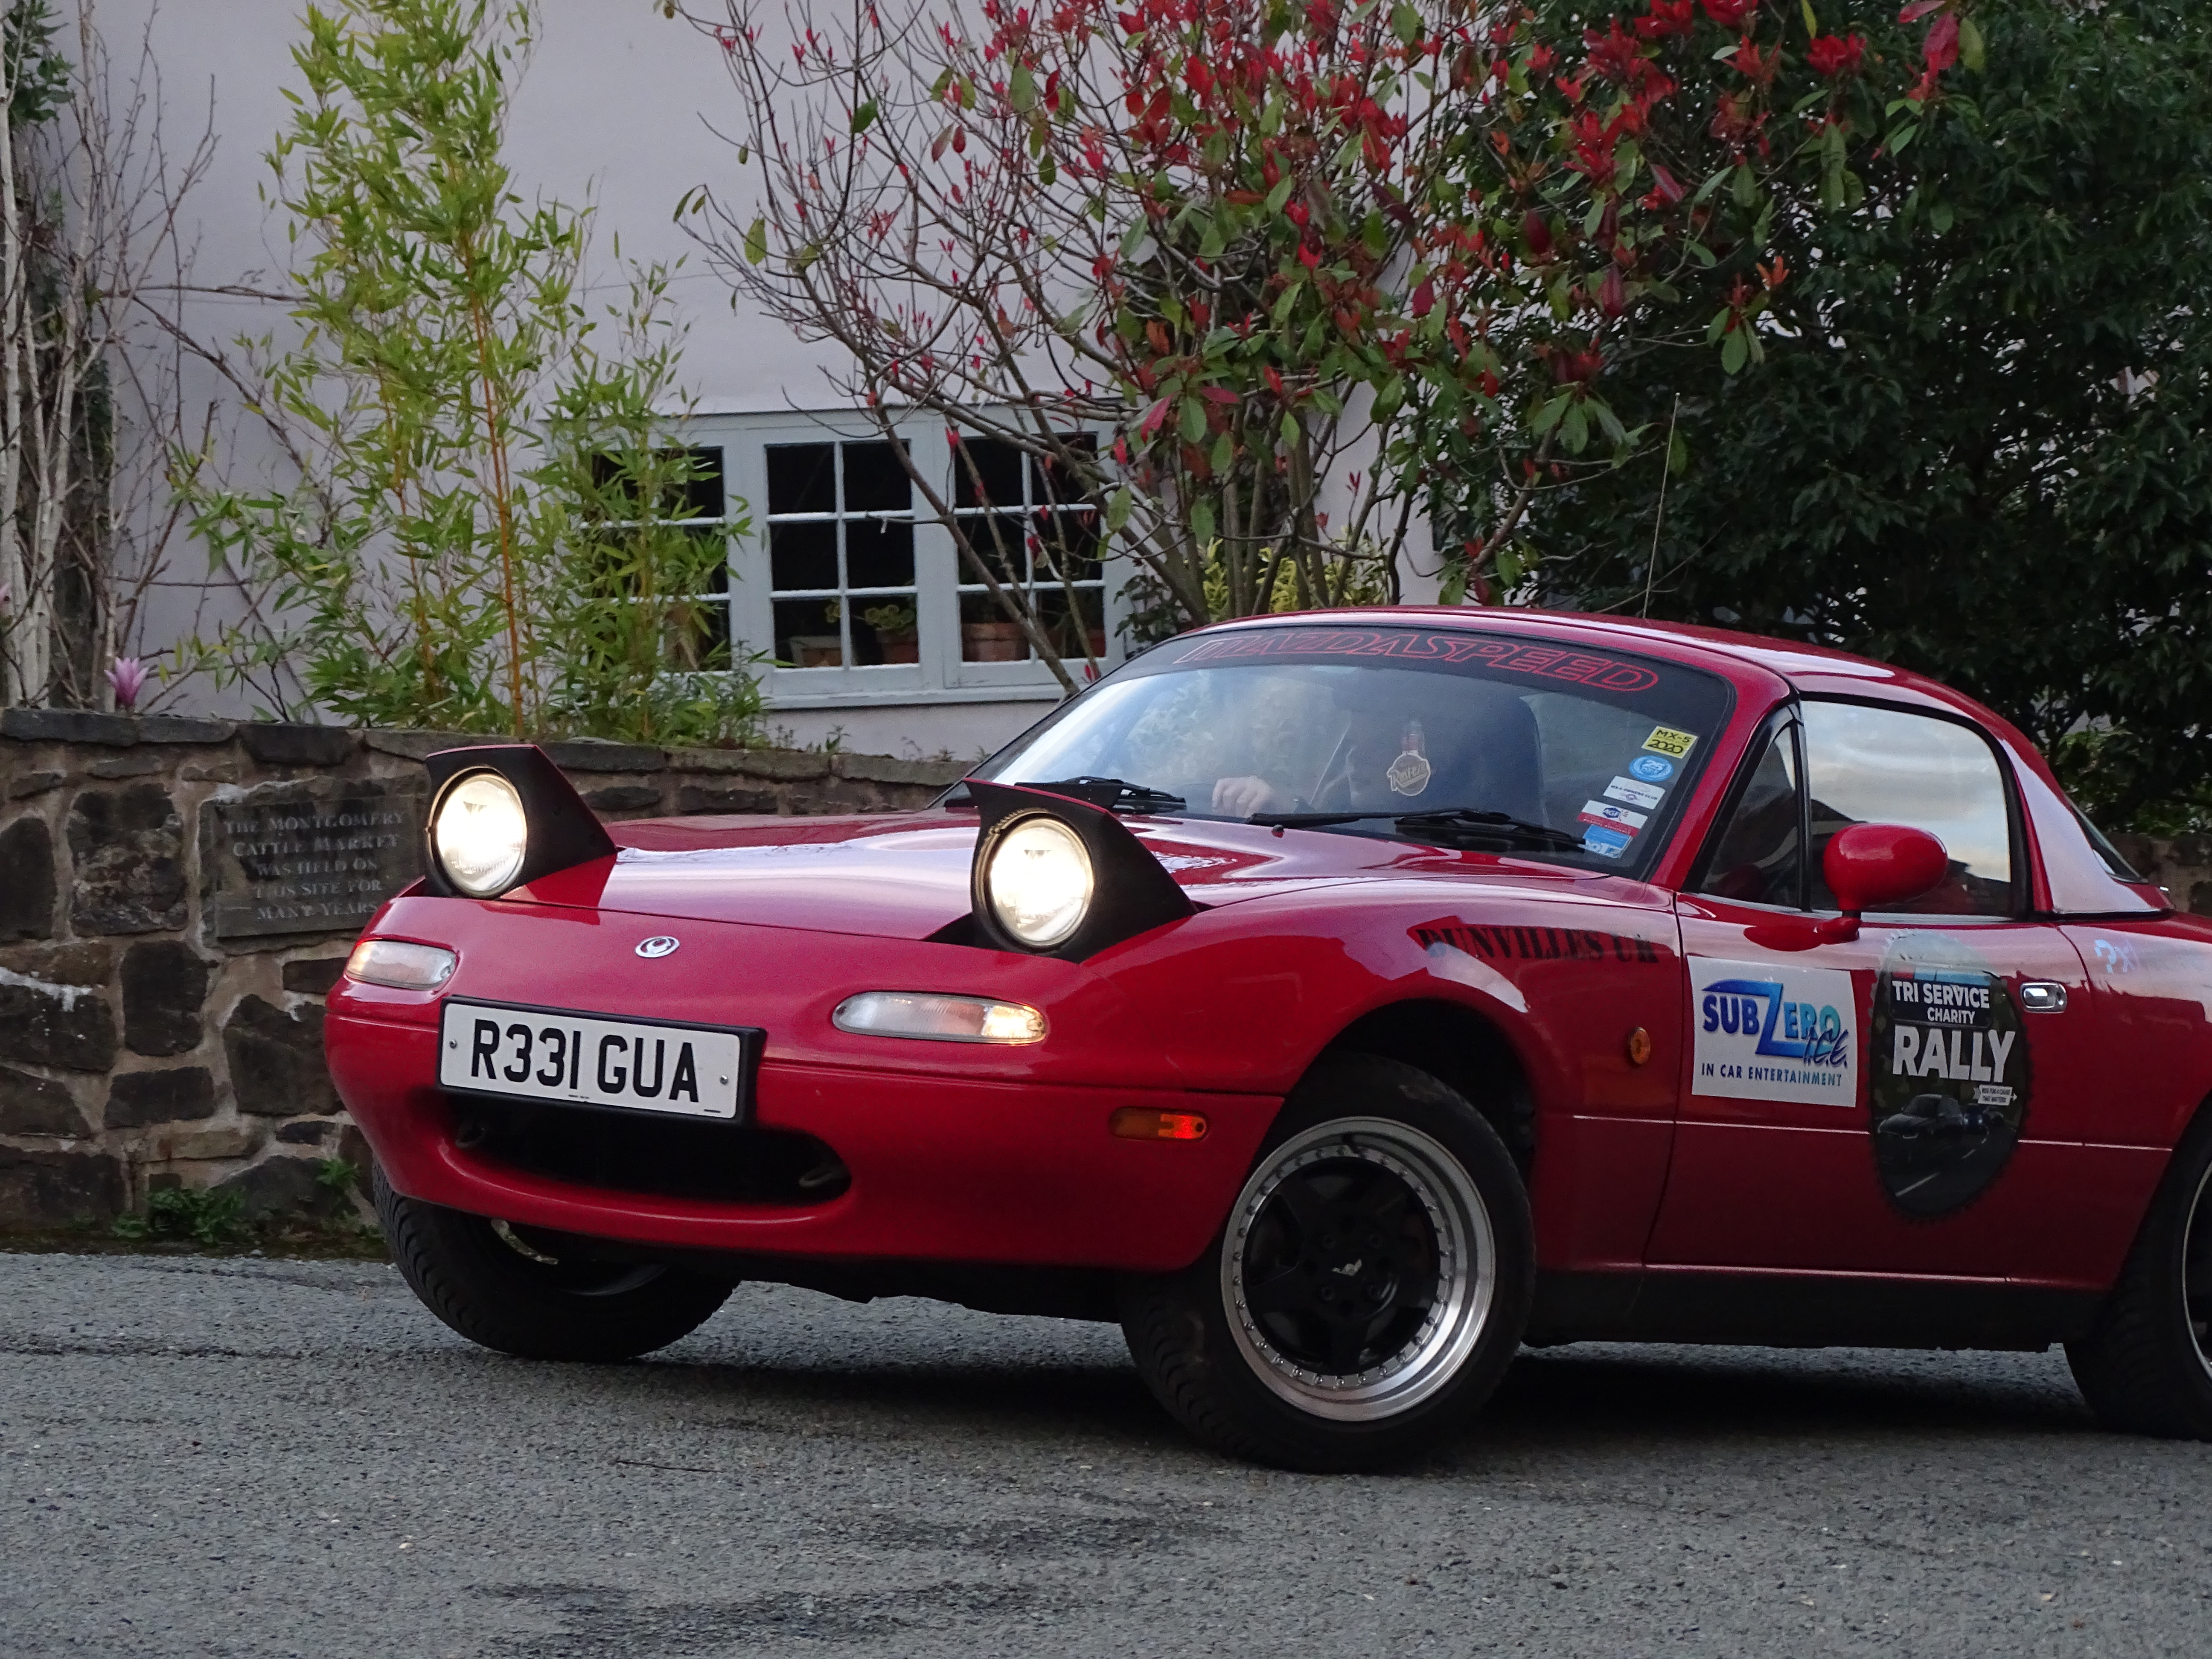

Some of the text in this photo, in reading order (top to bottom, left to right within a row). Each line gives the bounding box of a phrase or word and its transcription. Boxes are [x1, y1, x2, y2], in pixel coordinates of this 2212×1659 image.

[1173, 632, 1659, 692] MAZDASPEED
[1647, 739, 1684, 754] 2020
[1656, 730, 1692, 743] MX-5
[222, 812, 404, 834] THE MONTGOMERY
[233, 834, 399, 856] CATTLE MARKET
[256, 857, 378, 876] WAS HELD ON
[300, 881, 340, 895] SITE
[347, 879, 384, 892] FOR
[256, 901, 378, 919] MANY YEARS
[1892, 980, 1990, 1009] TRI SERVICE
[1927, 1007, 1976, 1024] CHARITY
[471, 1019, 699, 1103] R331 GUA
[1892, 1024, 2016, 1083] RALLY
[1701, 1063, 1842, 1086] IN CAR ENTERTAINMENT
